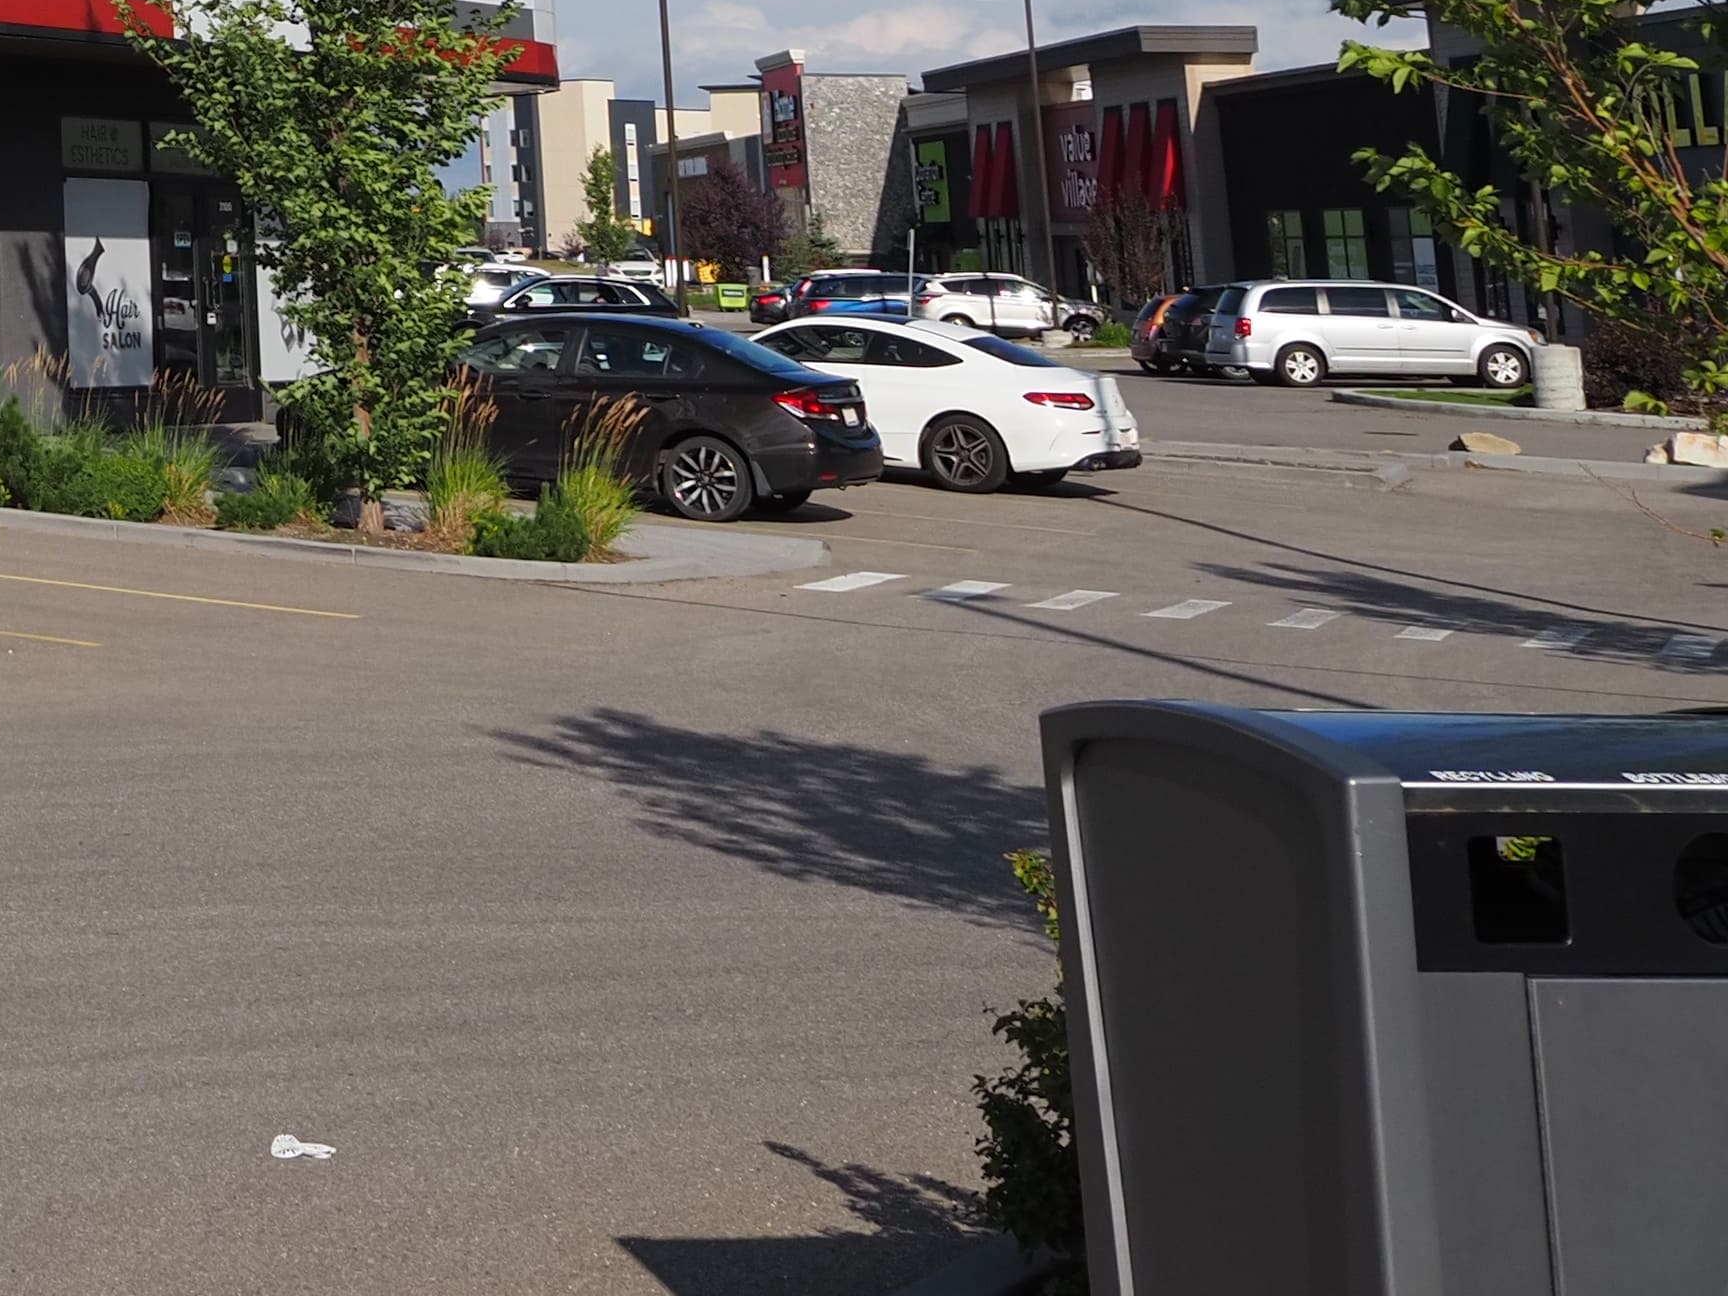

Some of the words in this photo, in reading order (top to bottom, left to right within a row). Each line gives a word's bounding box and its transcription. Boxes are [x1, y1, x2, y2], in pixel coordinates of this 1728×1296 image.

[81, 124, 106, 141] HAIR
[1059, 123, 1092, 161] value
[71, 145, 129, 166] ESTHETICS
[1060, 168, 1098, 208] village
[103, 288, 140, 330] Hair
[103, 331, 141, 350] SALON
